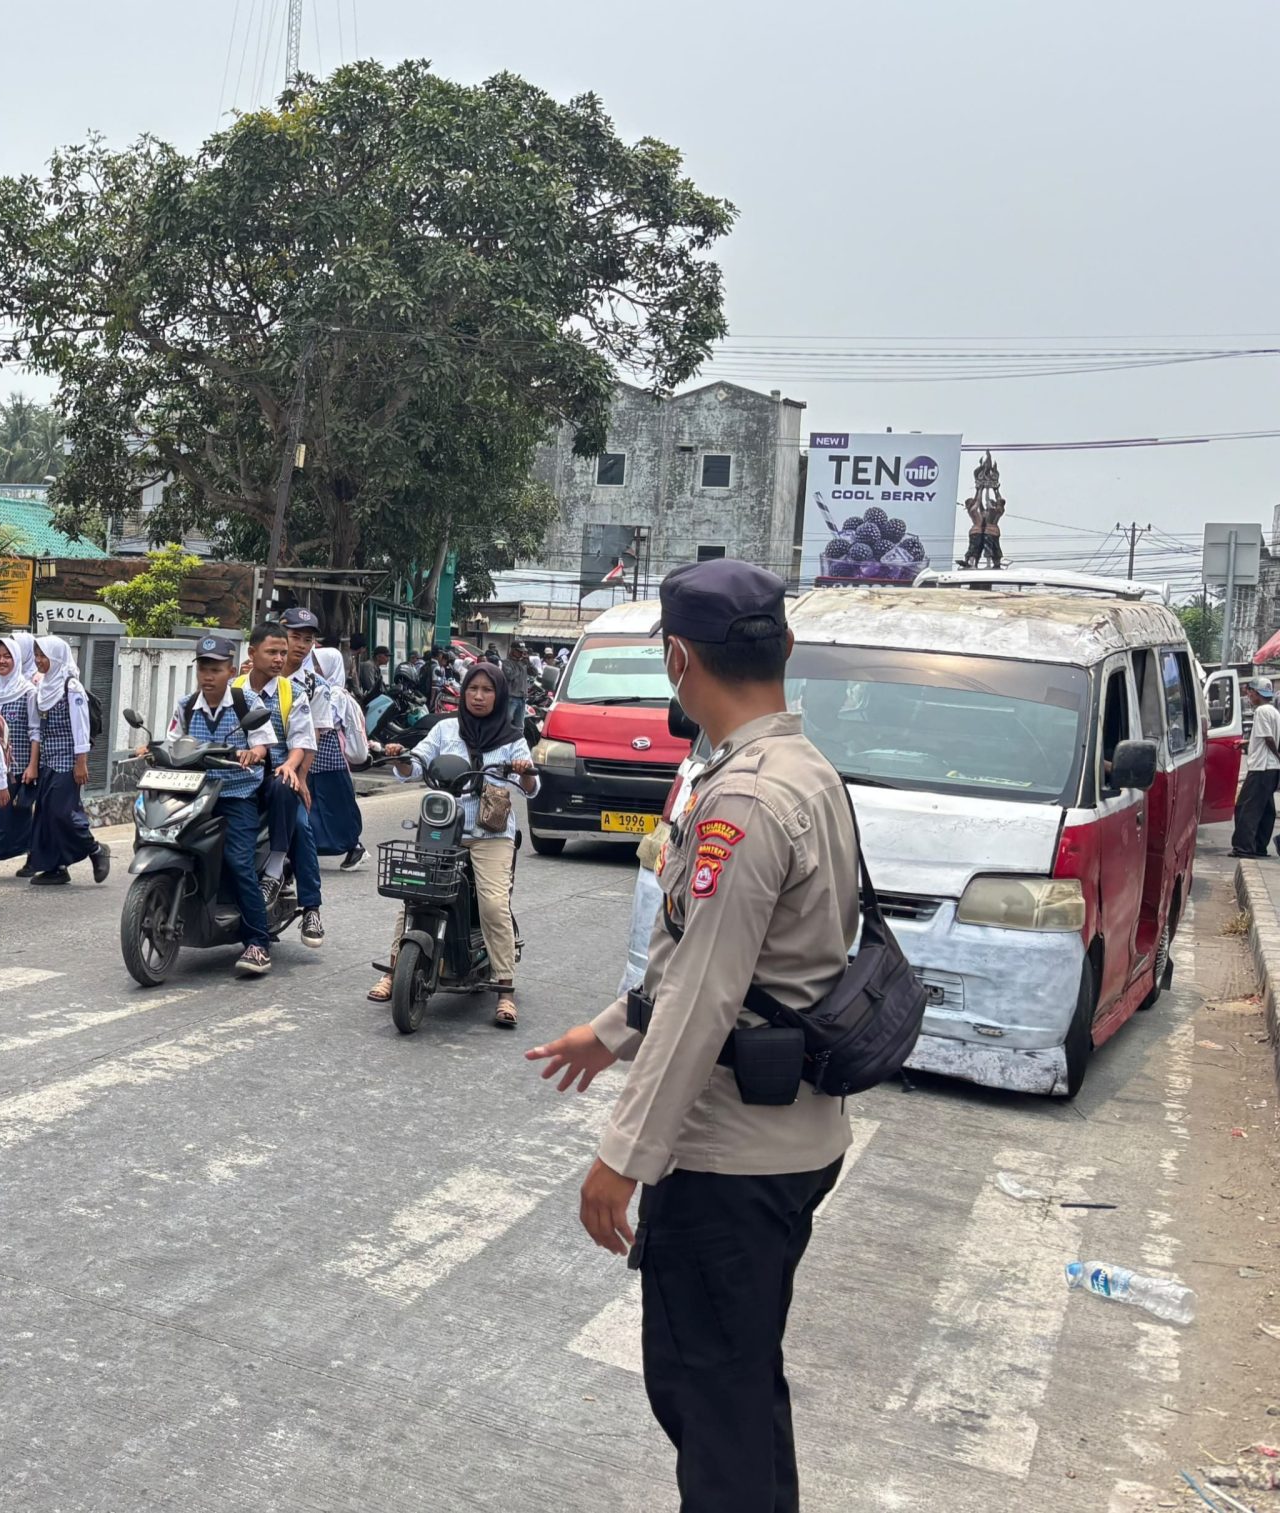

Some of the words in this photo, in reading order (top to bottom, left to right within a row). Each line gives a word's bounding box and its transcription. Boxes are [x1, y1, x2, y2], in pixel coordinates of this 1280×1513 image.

[816, 437, 838, 446] NEW
[828, 455, 901, 486] TEN
[905, 465, 938, 480] mild
[831, 489, 874, 501] COOL
[881, 490, 936, 502] BERRY
[36, 608, 106, 623] SEKOLA
[604, 813, 610, 824] A
[619, 815, 645, 827] 1996
